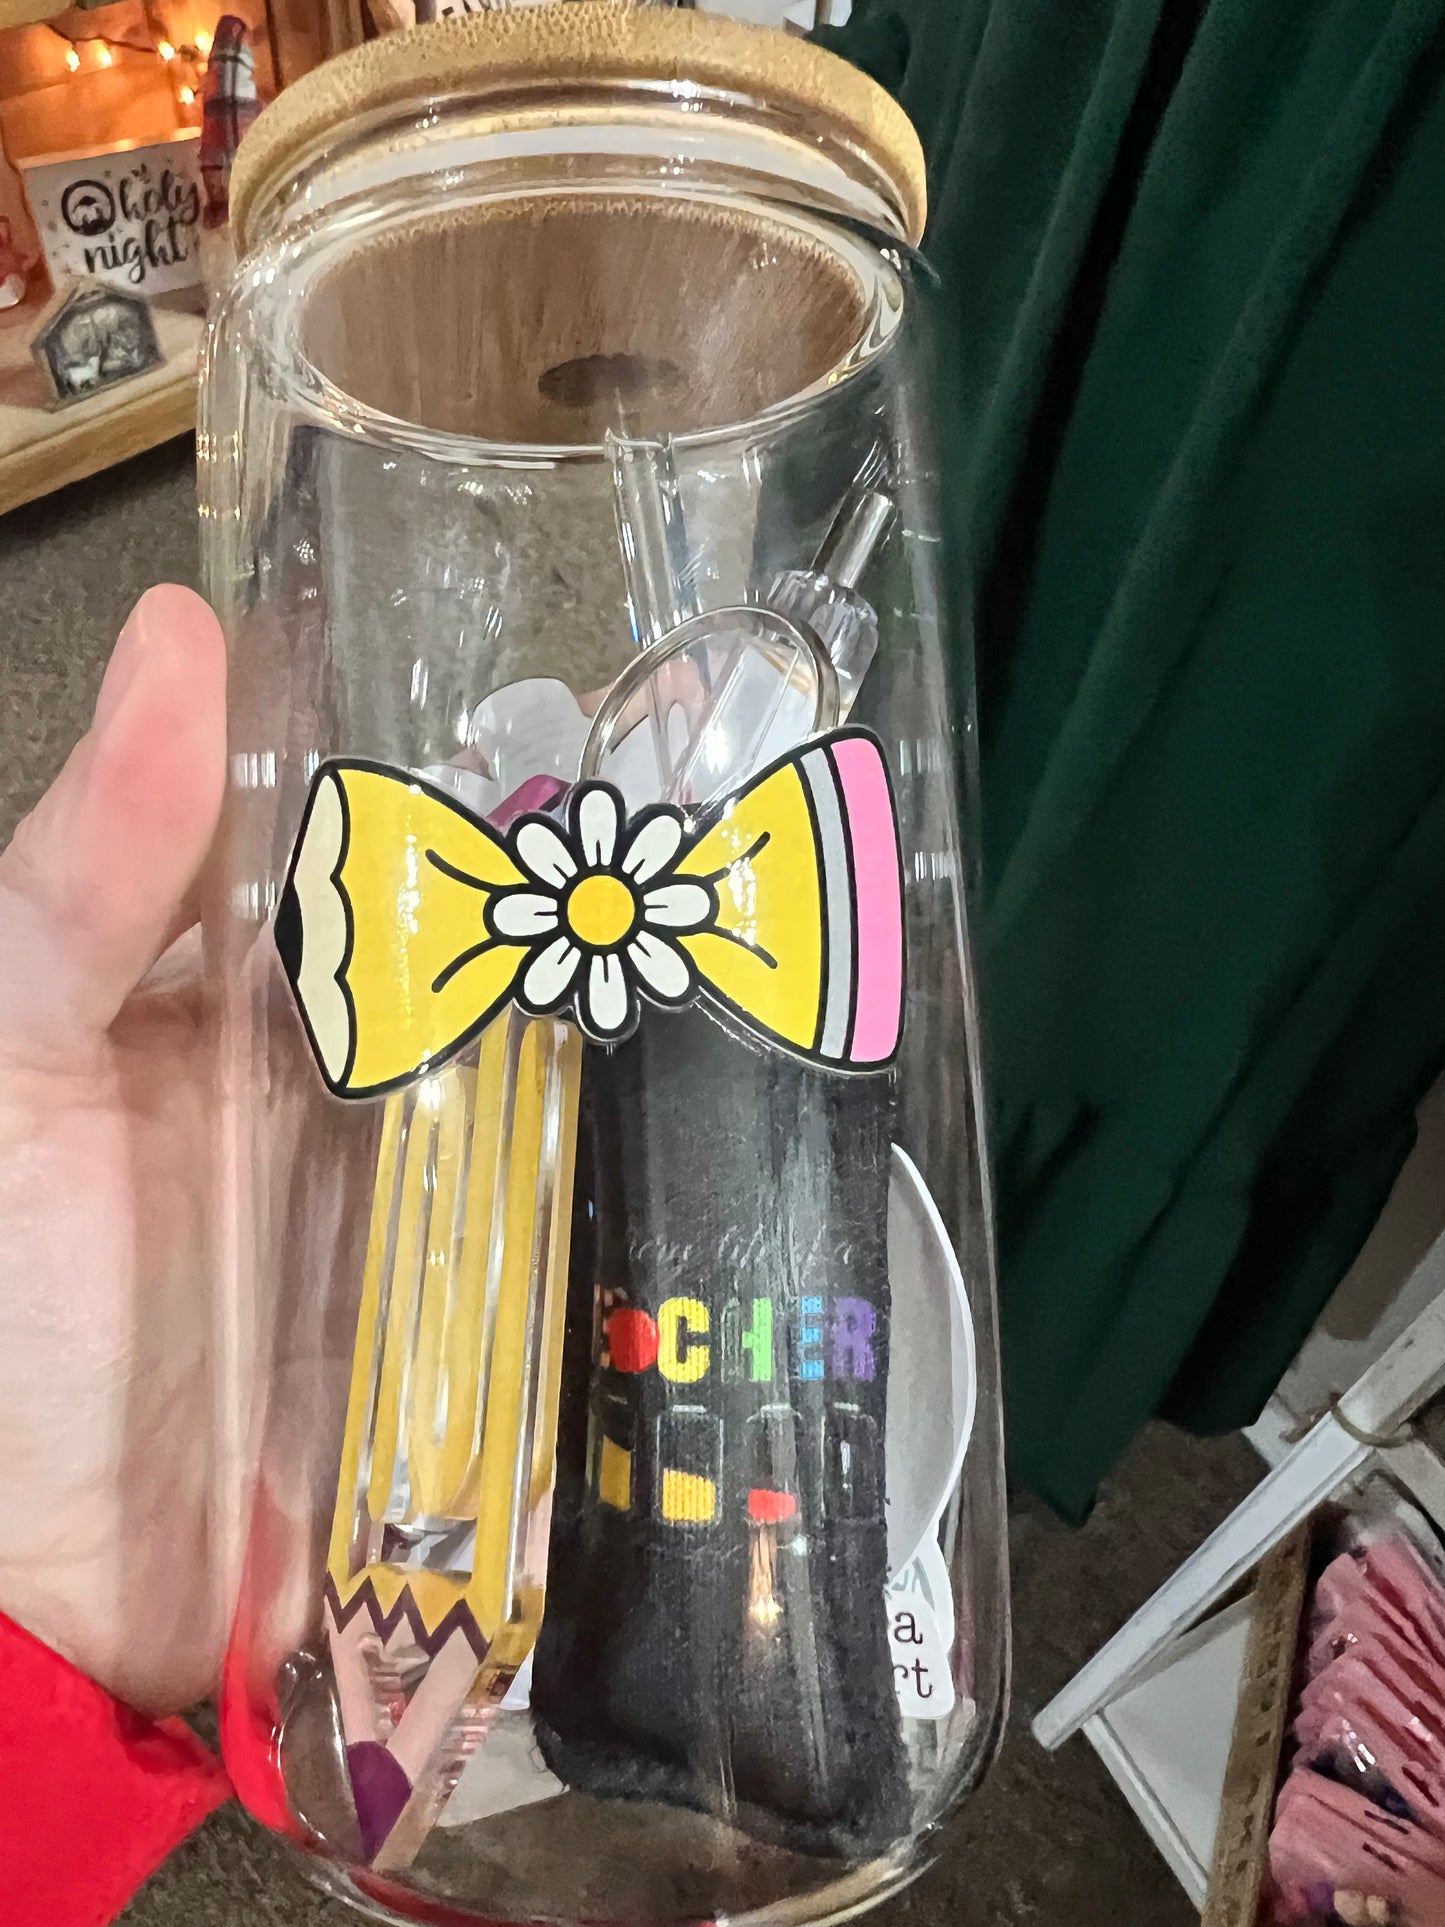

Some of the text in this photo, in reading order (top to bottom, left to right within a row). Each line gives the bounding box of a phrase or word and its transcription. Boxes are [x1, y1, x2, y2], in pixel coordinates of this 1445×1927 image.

[119, 169, 199, 224] holy
[84, 217, 189, 284] night
[608, 1295, 877, 1384] CHER
